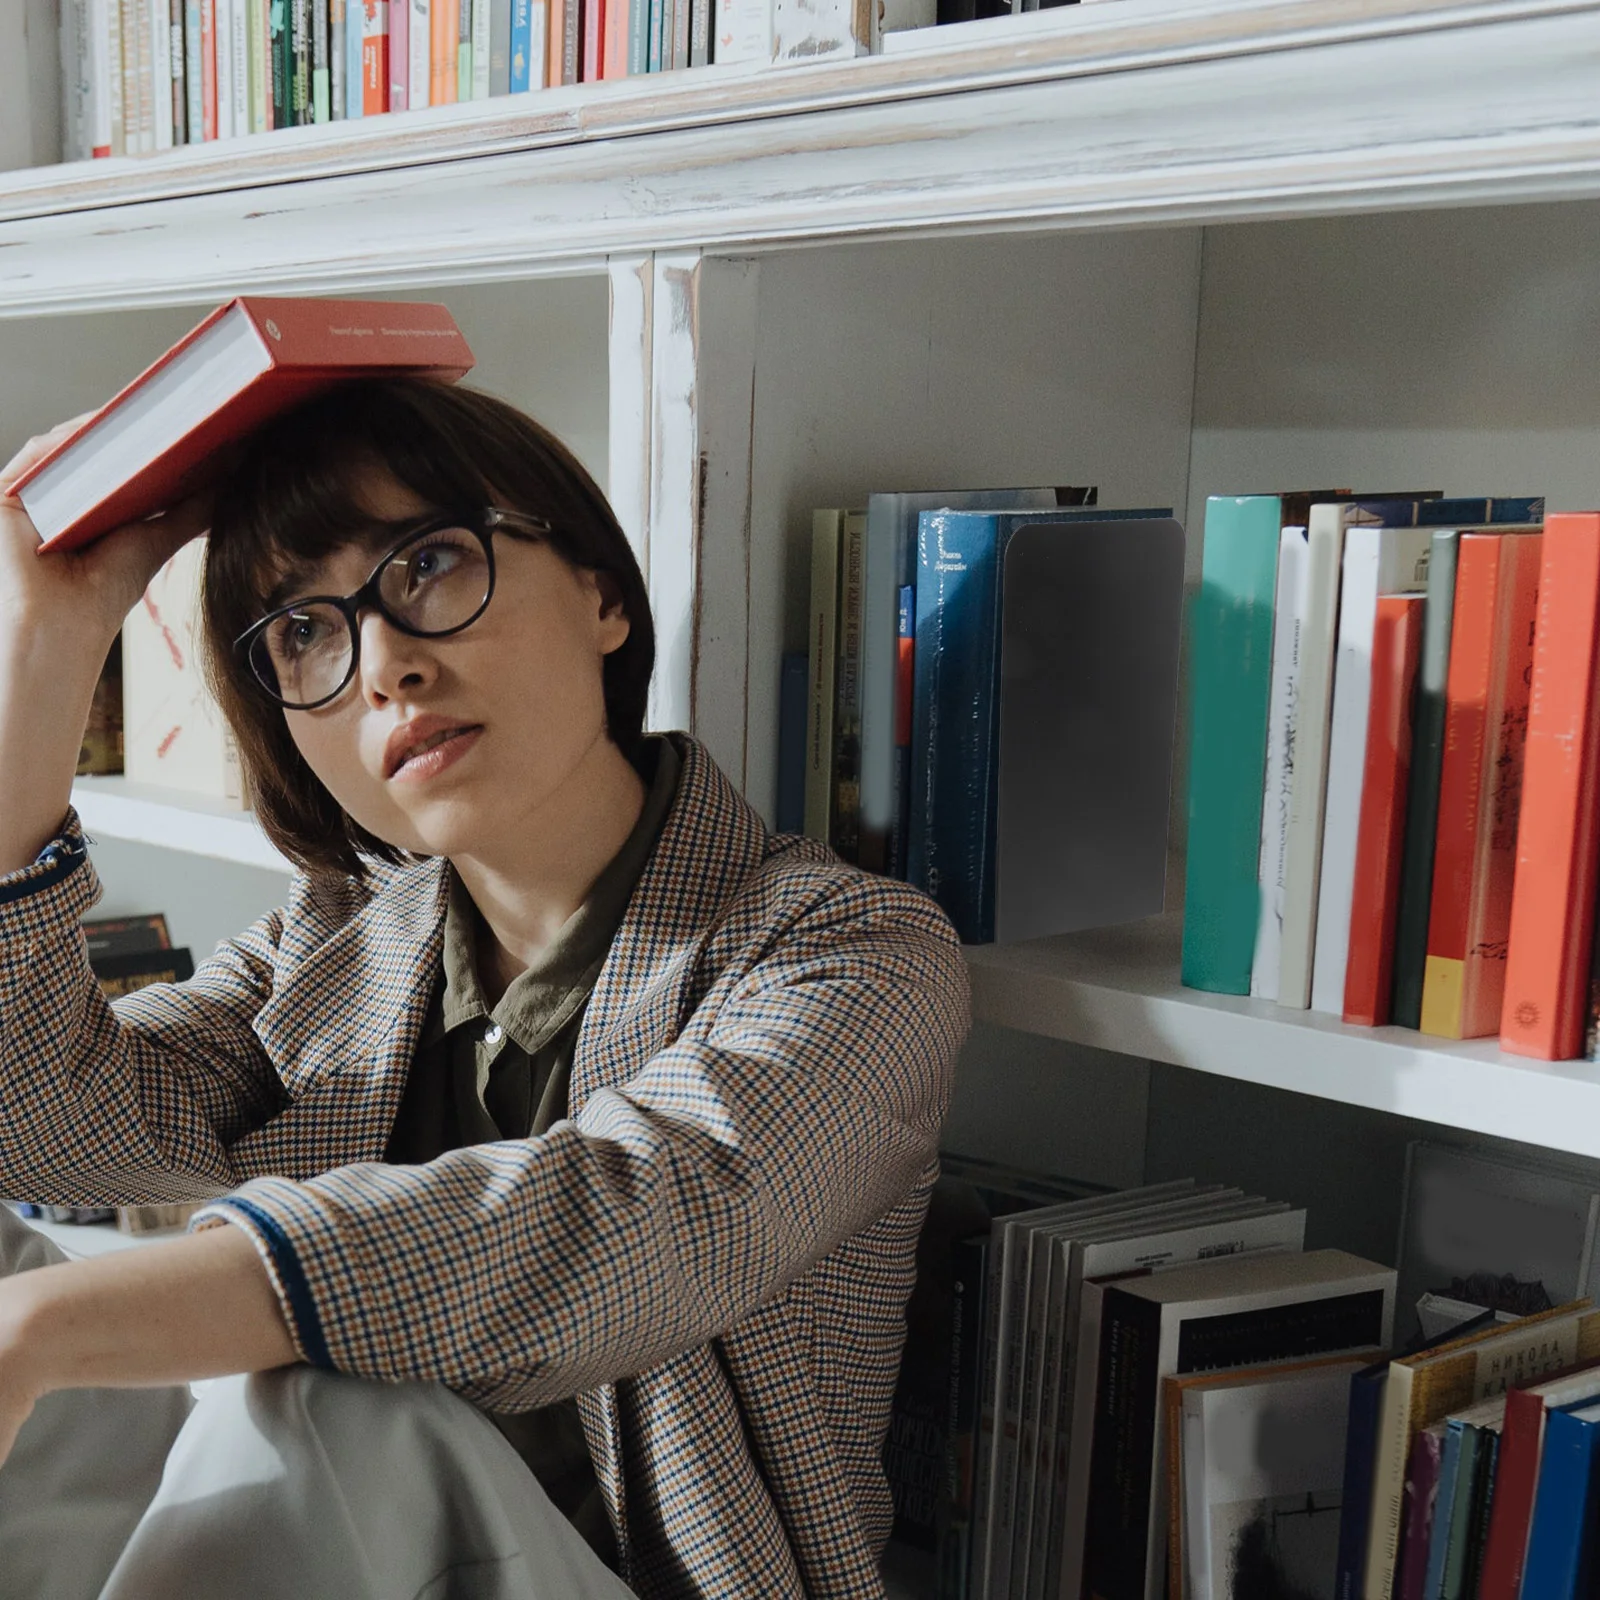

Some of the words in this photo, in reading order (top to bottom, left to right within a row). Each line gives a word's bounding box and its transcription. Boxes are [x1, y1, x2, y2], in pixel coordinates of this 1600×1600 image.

[940, 551, 962, 560] миль
[899, 618, 907, 633] Юм
[847, 634, 858, 659] ИДЕЯ
[1110, 1319, 1120, 1352] КАРЕН
[1491, 1340, 1559, 1373] НИКОЛА
